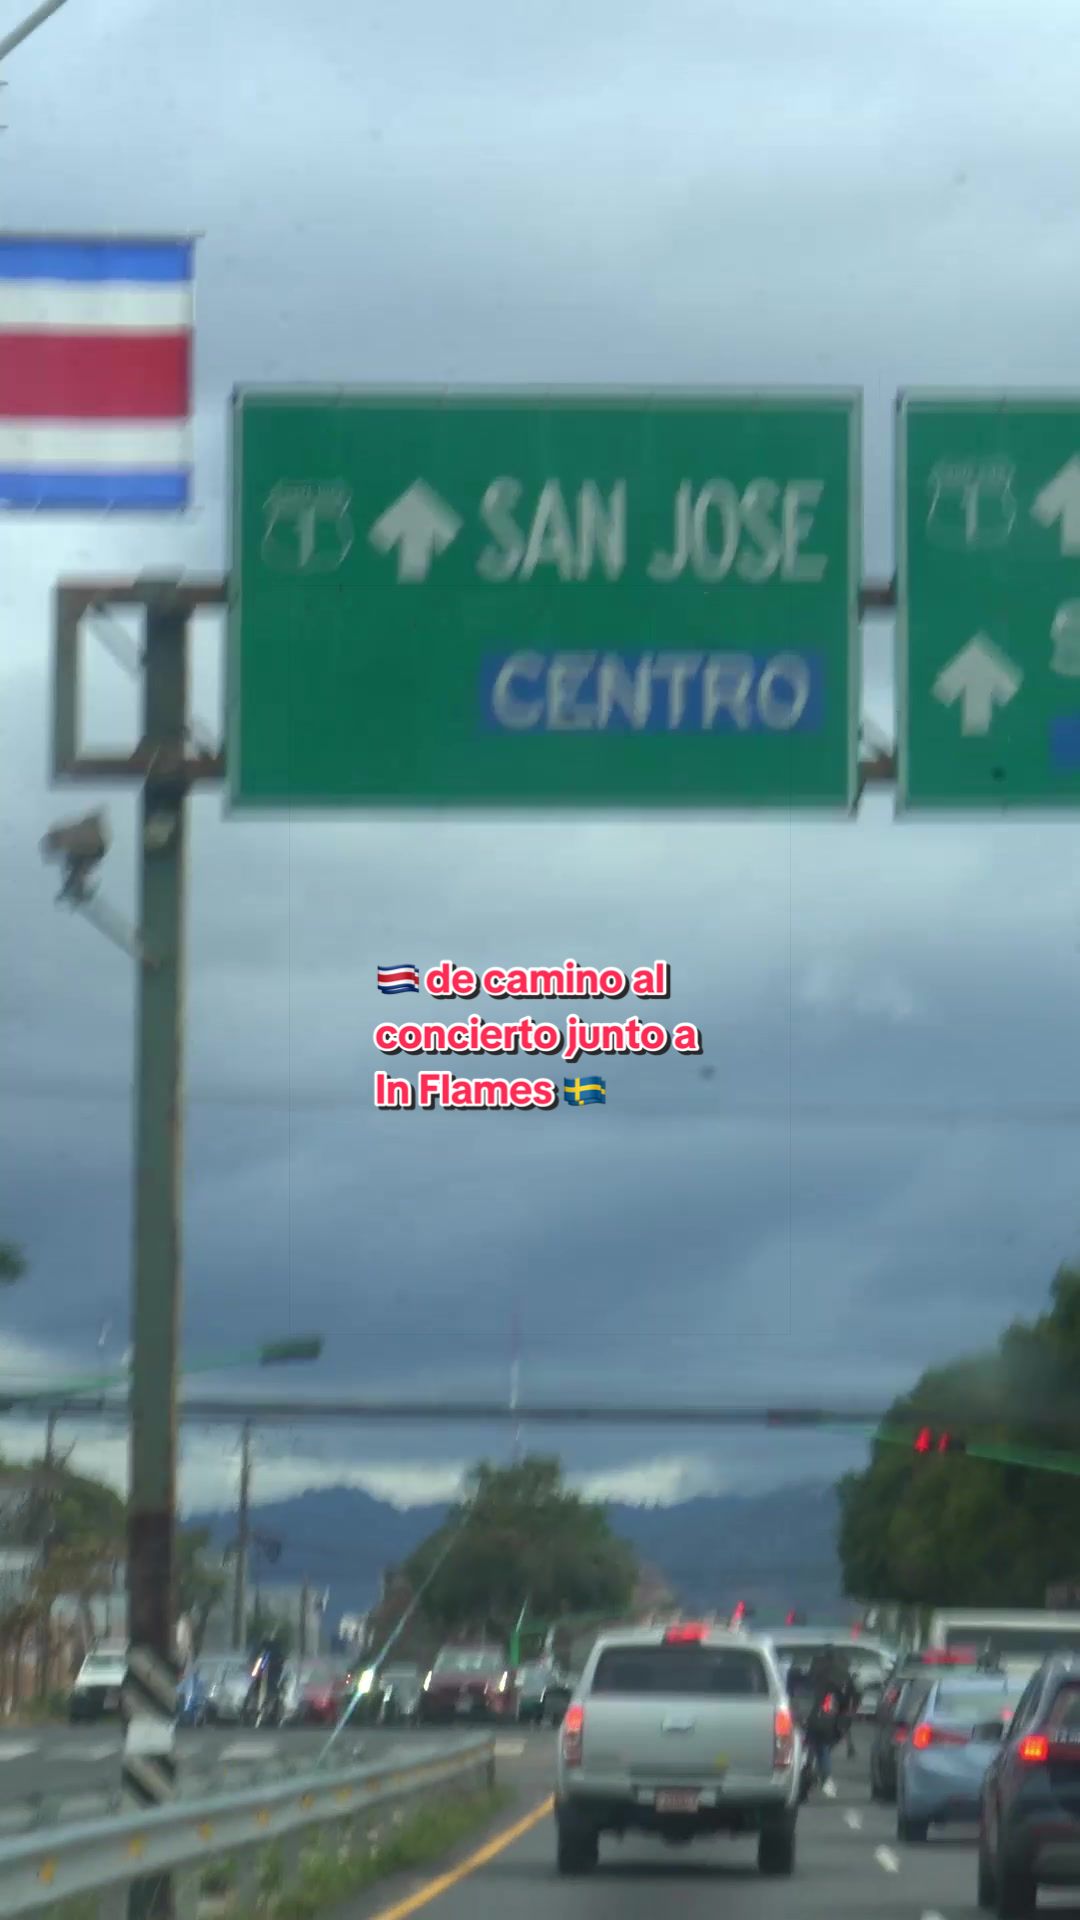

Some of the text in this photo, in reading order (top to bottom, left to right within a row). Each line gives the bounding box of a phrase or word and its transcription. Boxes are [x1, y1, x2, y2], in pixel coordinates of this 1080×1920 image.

[475, 475, 828, 583] SAN JOSE
[491, 650, 811, 731] CENTRO
